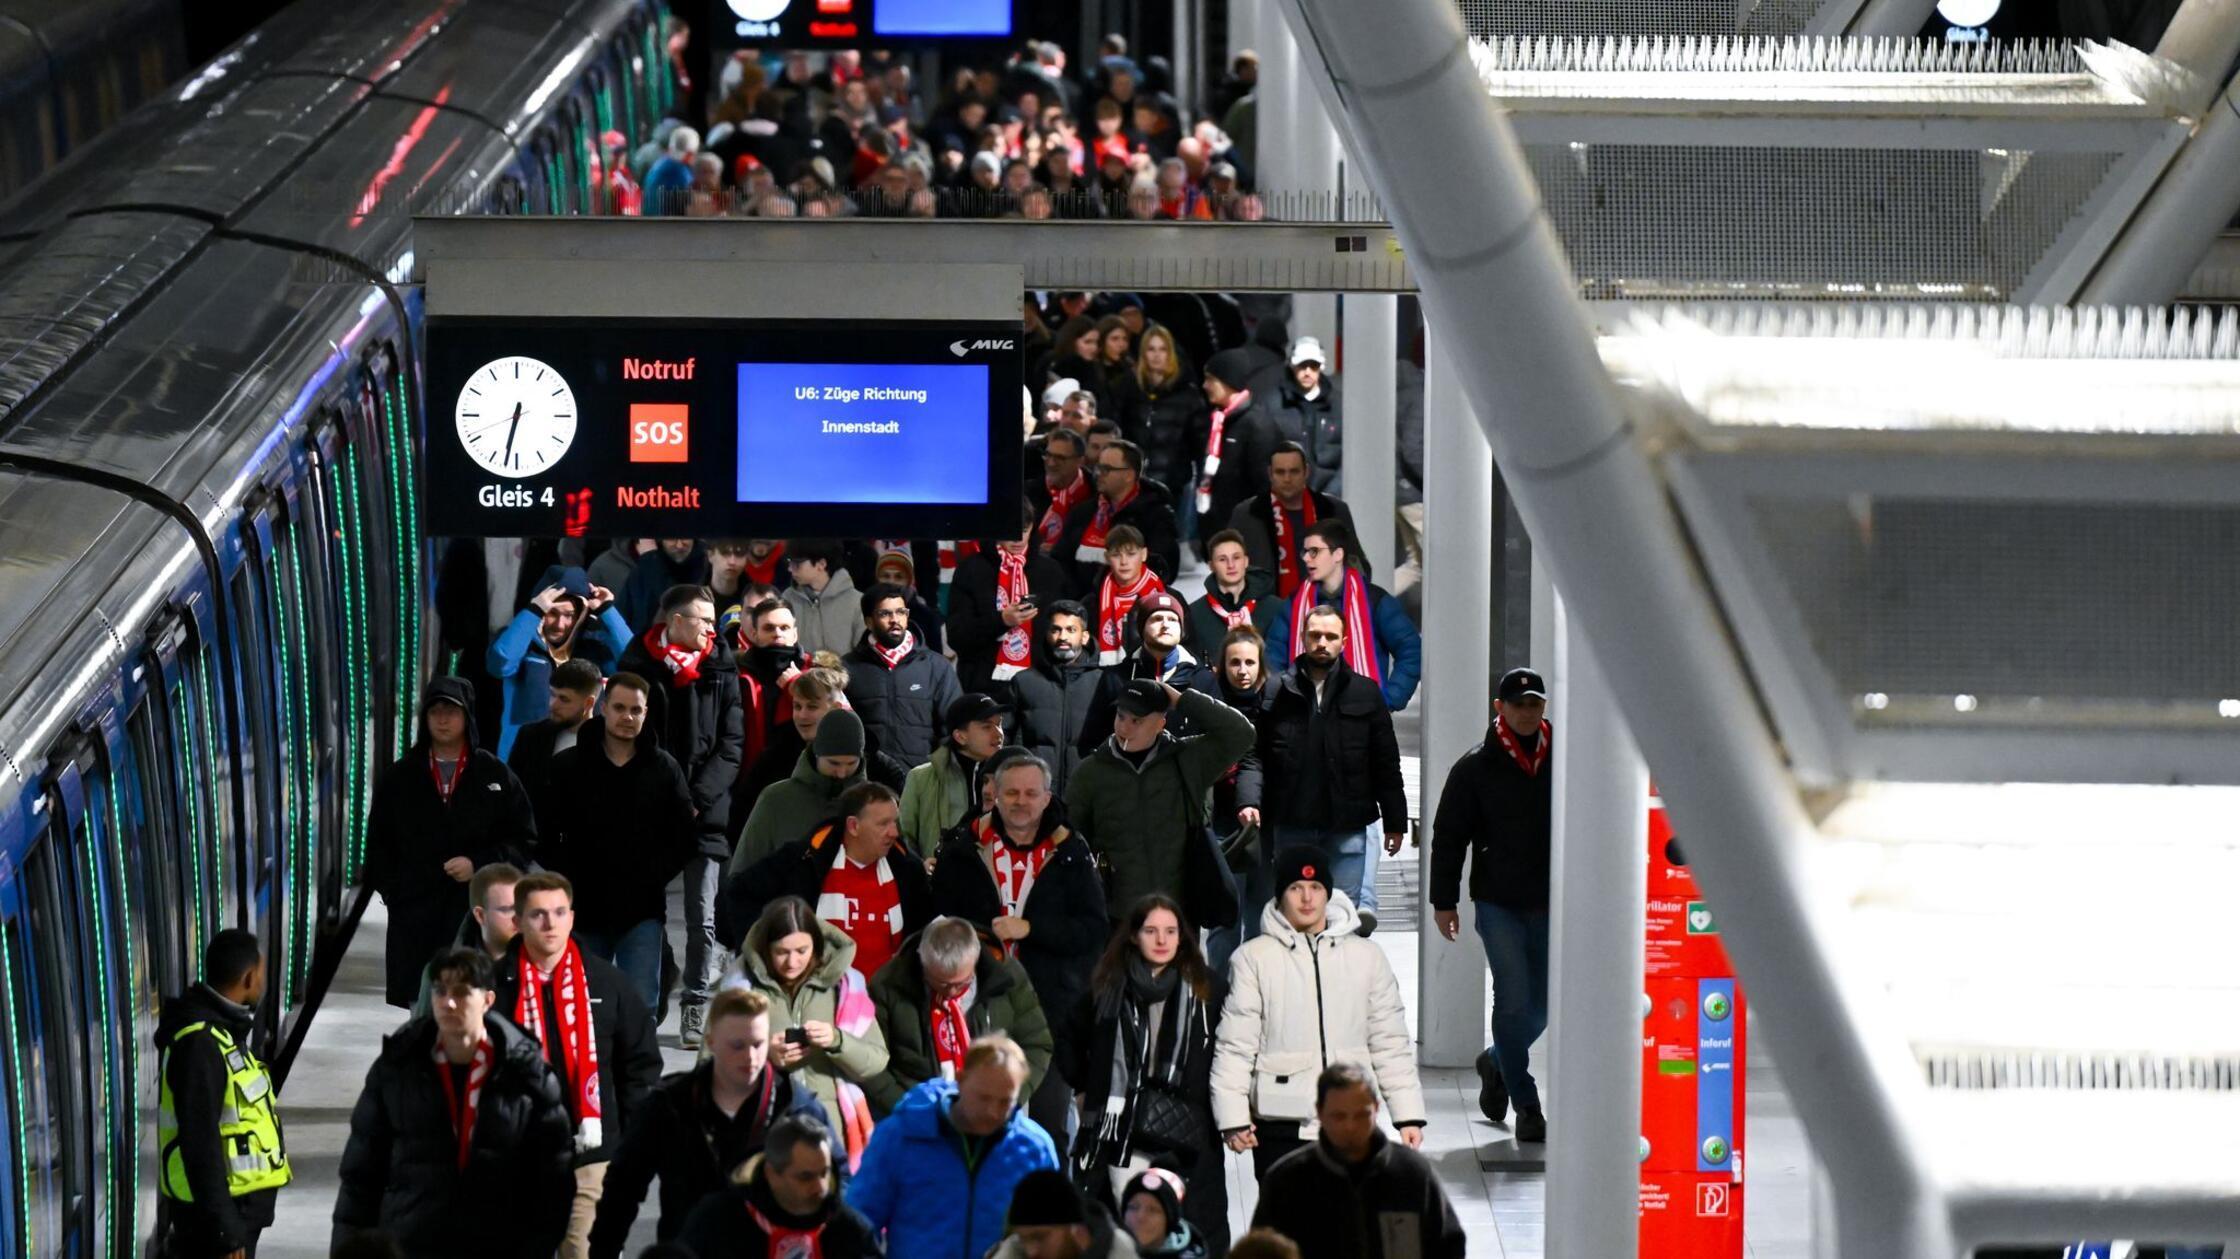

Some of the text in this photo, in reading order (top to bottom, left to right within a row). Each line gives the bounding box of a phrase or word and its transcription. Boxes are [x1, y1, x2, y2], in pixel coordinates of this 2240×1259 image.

[970, 339, 1014, 350] MVG
[624, 357, 696, 380] Notruf
[795, 387, 927, 403] U6: Züge Richtung
[633, 421, 684, 445] SOS
[822, 420, 900, 434] Innenstadt
[478, 484, 556, 508] Gleis 4
[617, 485, 700, 509] Nothalt
